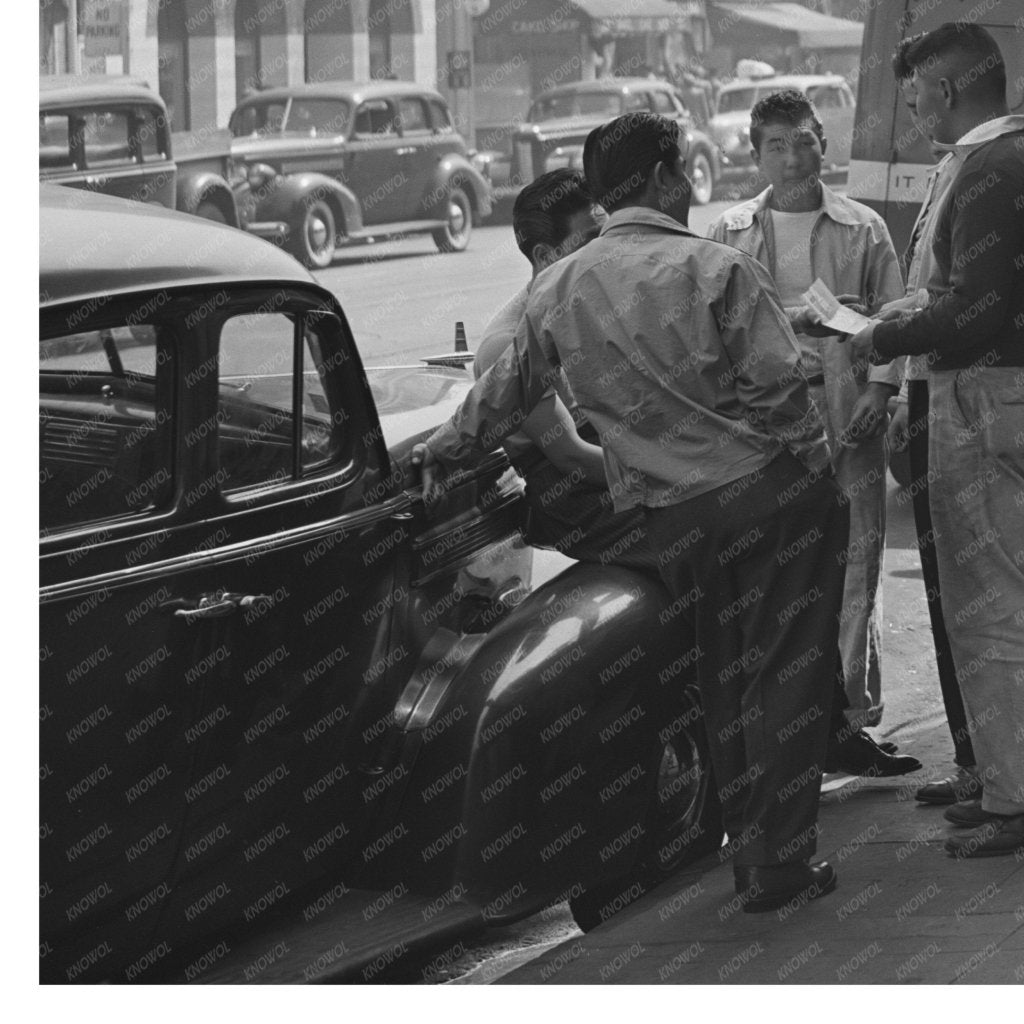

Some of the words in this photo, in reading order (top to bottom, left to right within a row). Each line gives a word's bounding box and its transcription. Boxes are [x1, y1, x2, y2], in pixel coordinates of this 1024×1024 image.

[96, 10, 110, 22] NO
[86, 24, 121, 38] PARKING
[895, 175, 915, 189] IT
